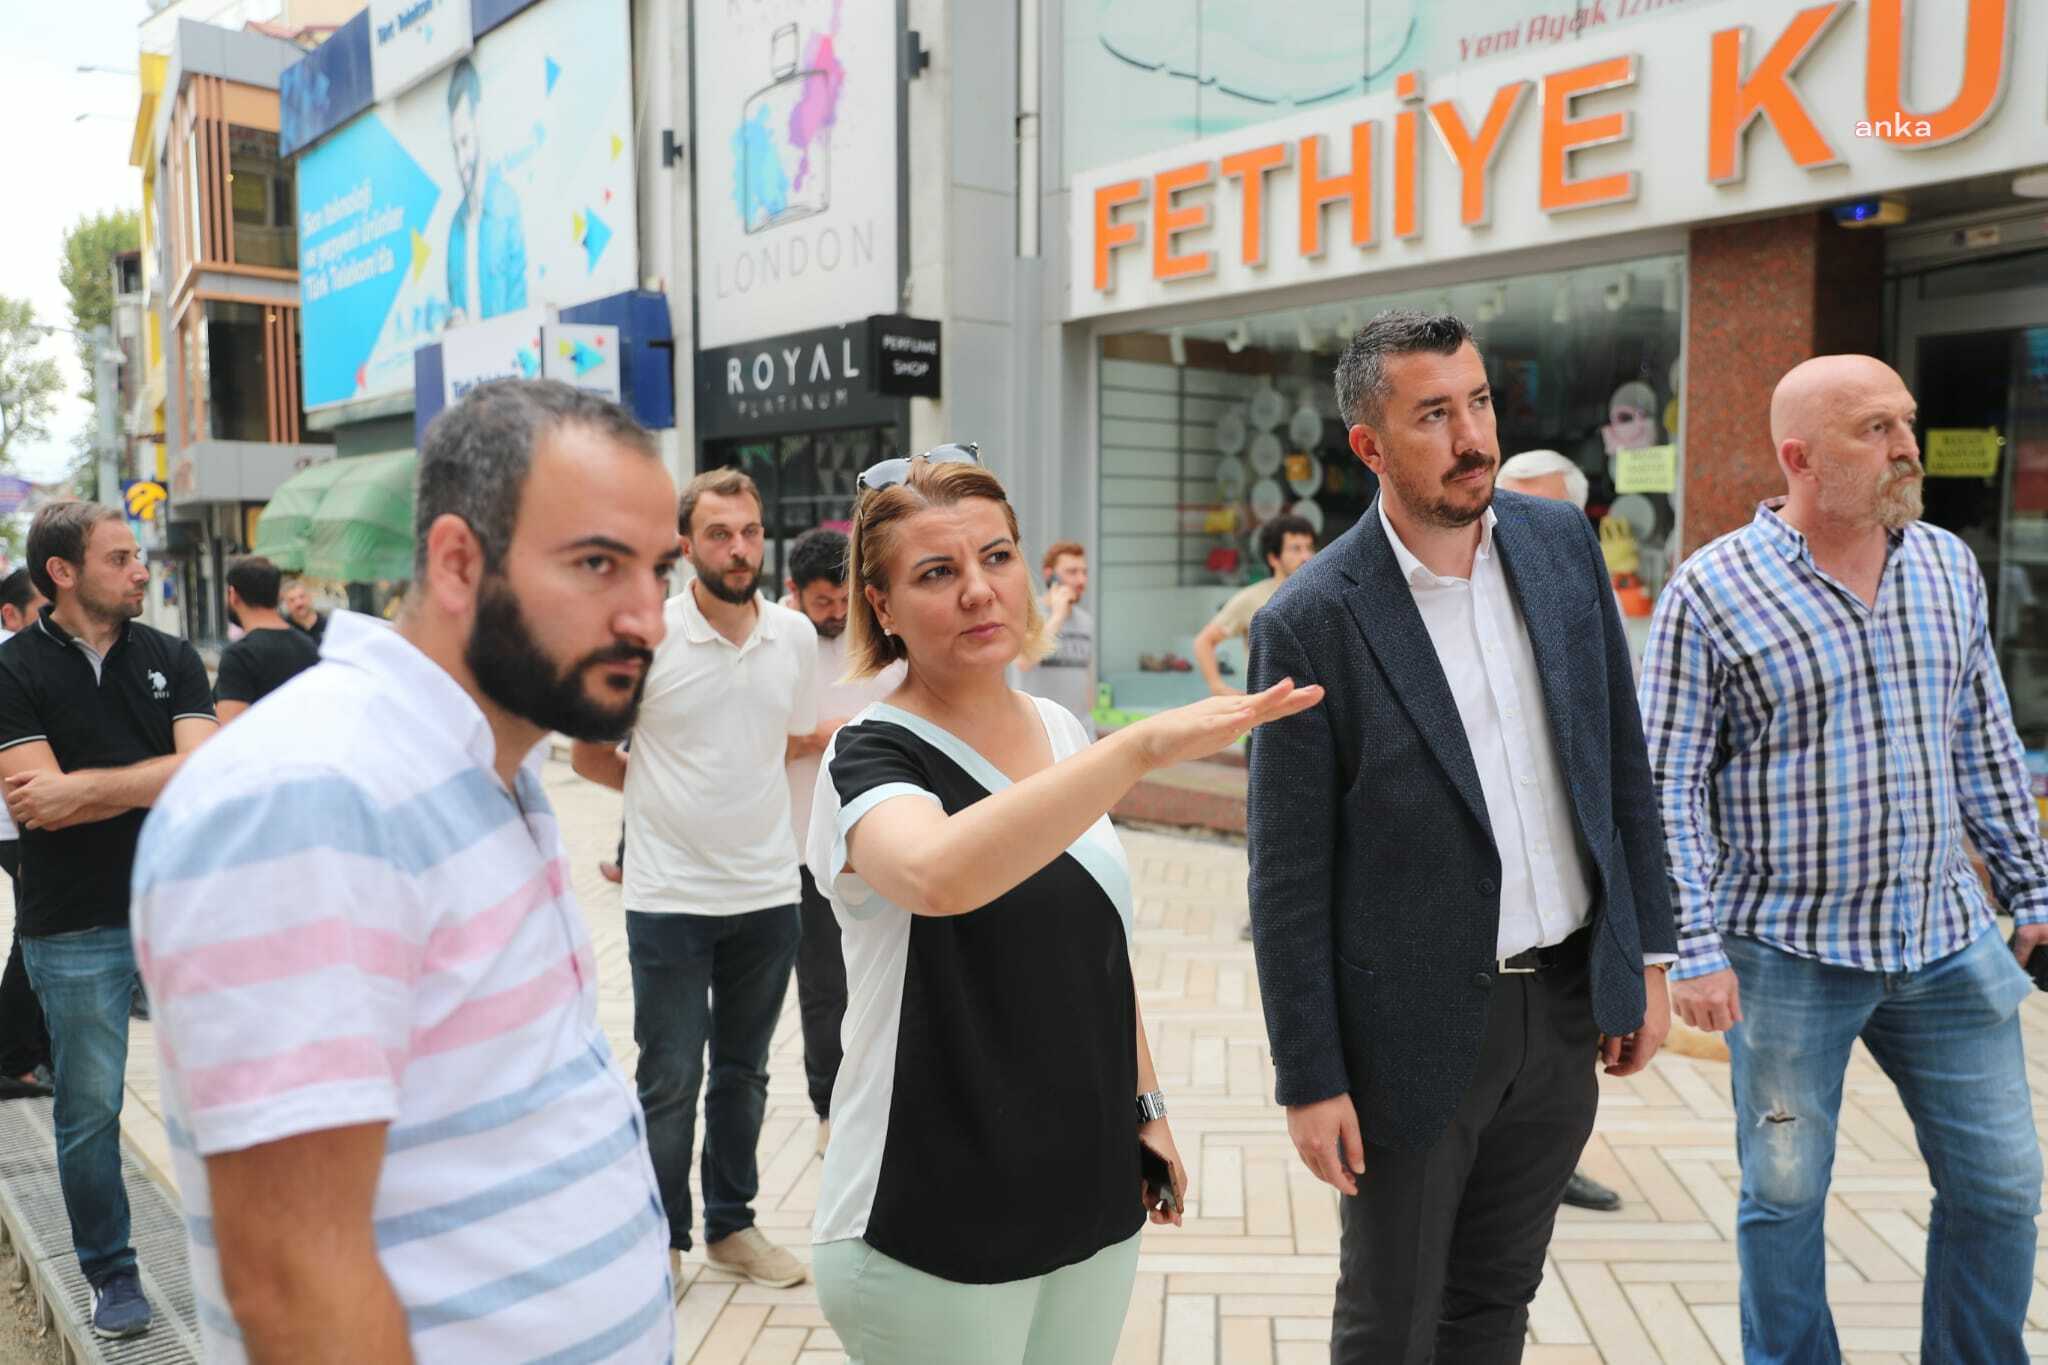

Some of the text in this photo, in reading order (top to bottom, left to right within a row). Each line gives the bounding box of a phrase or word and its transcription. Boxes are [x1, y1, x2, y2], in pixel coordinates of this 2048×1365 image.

[1459, 23, 1520, 61] Yeni
[1094, 0, 2048, 293] FETHİYE KU
[717, 220, 874, 299] LONDON
[882, 334, 937, 355] PERFUME
[726, 338, 860, 395] ROYAL
[893, 359, 930, 377] SHOP
[738, 388, 849, 419] PLATINUM
